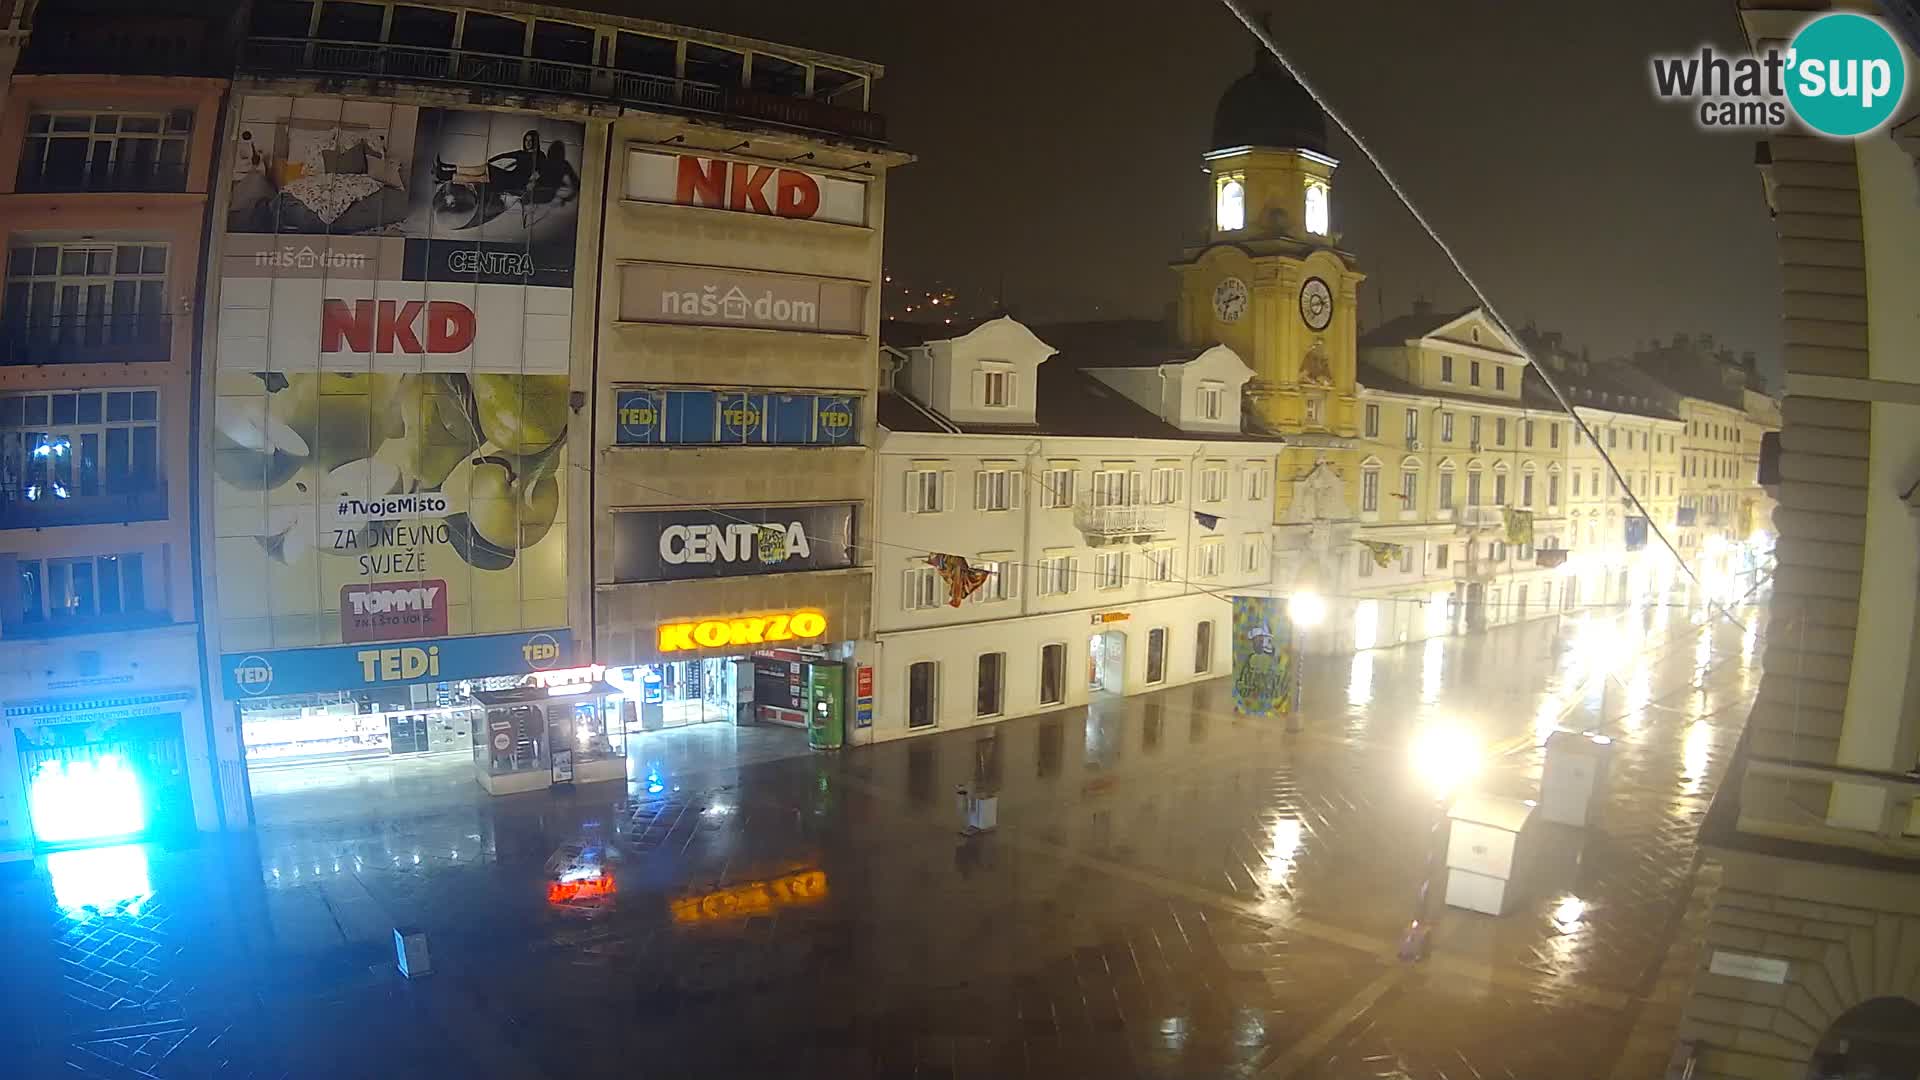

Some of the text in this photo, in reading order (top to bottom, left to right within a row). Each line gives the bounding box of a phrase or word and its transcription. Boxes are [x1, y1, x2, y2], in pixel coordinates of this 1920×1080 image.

[675, 154, 821, 219] NKD
[254, 246, 366, 270] naš dom
[447, 249, 535, 277] CENTRA
[661, 284, 817, 324] naš dom
[320, 298, 477, 354] NKD
[618, 407, 658, 426] TEDi
[723, 408, 760, 427] TEDi
[819, 411, 853, 428] TEDi
[338, 497, 447, 517] #TvojeMisto
[333, 524, 450, 549] ZA DNEVNO
[659, 520, 810, 565] CENTA
[359, 547, 427, 575] SVJEŽE
[349, 586, 440, 615] TOMMY
[657, 610, 828, 652] KORZO
[234, 666, 273, 685] TEDi
[358, 646, 440, 682] TEDi
